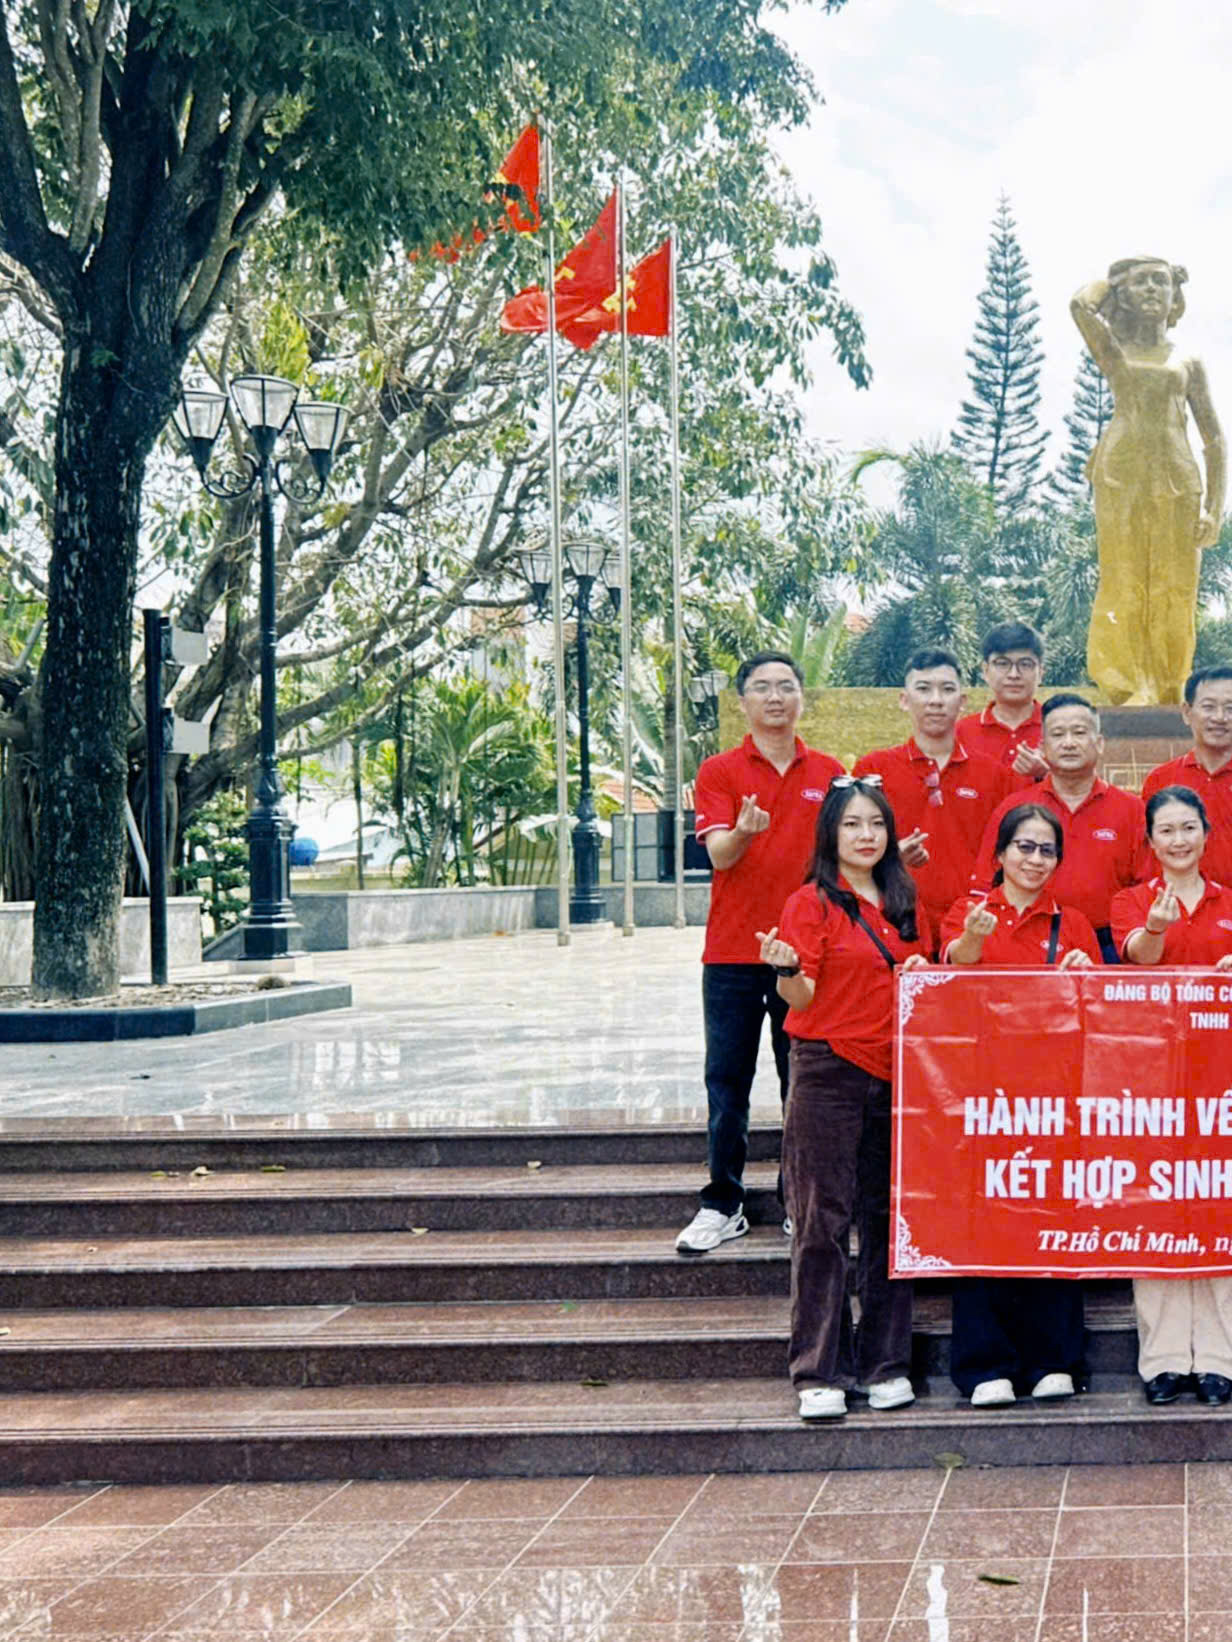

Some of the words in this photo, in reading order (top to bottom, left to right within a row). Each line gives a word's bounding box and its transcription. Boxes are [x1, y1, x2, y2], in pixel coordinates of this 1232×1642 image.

[1103, 979, 1147, 1001] ĐẢNG
[1151, 981, 1171, 1004] BỘ
[1175, 978, 1215, 1003] TỔNG
[1189, 1011, 1229, 1029] TNHH
[964, 1088, 1065, 1136] HÀNH
[1075, 1088, 1185, 1137] TRÌNH
[985, 1146, 1052, 1199] KẾT
[1063, 1155, 1137, 1208] HỢP
[1037, 1225, 1100, 1252] TP.Hồ
[1103, 1225, 1144, 1252] Chí
[1146, 1231, 1206, 1256] Minh,
